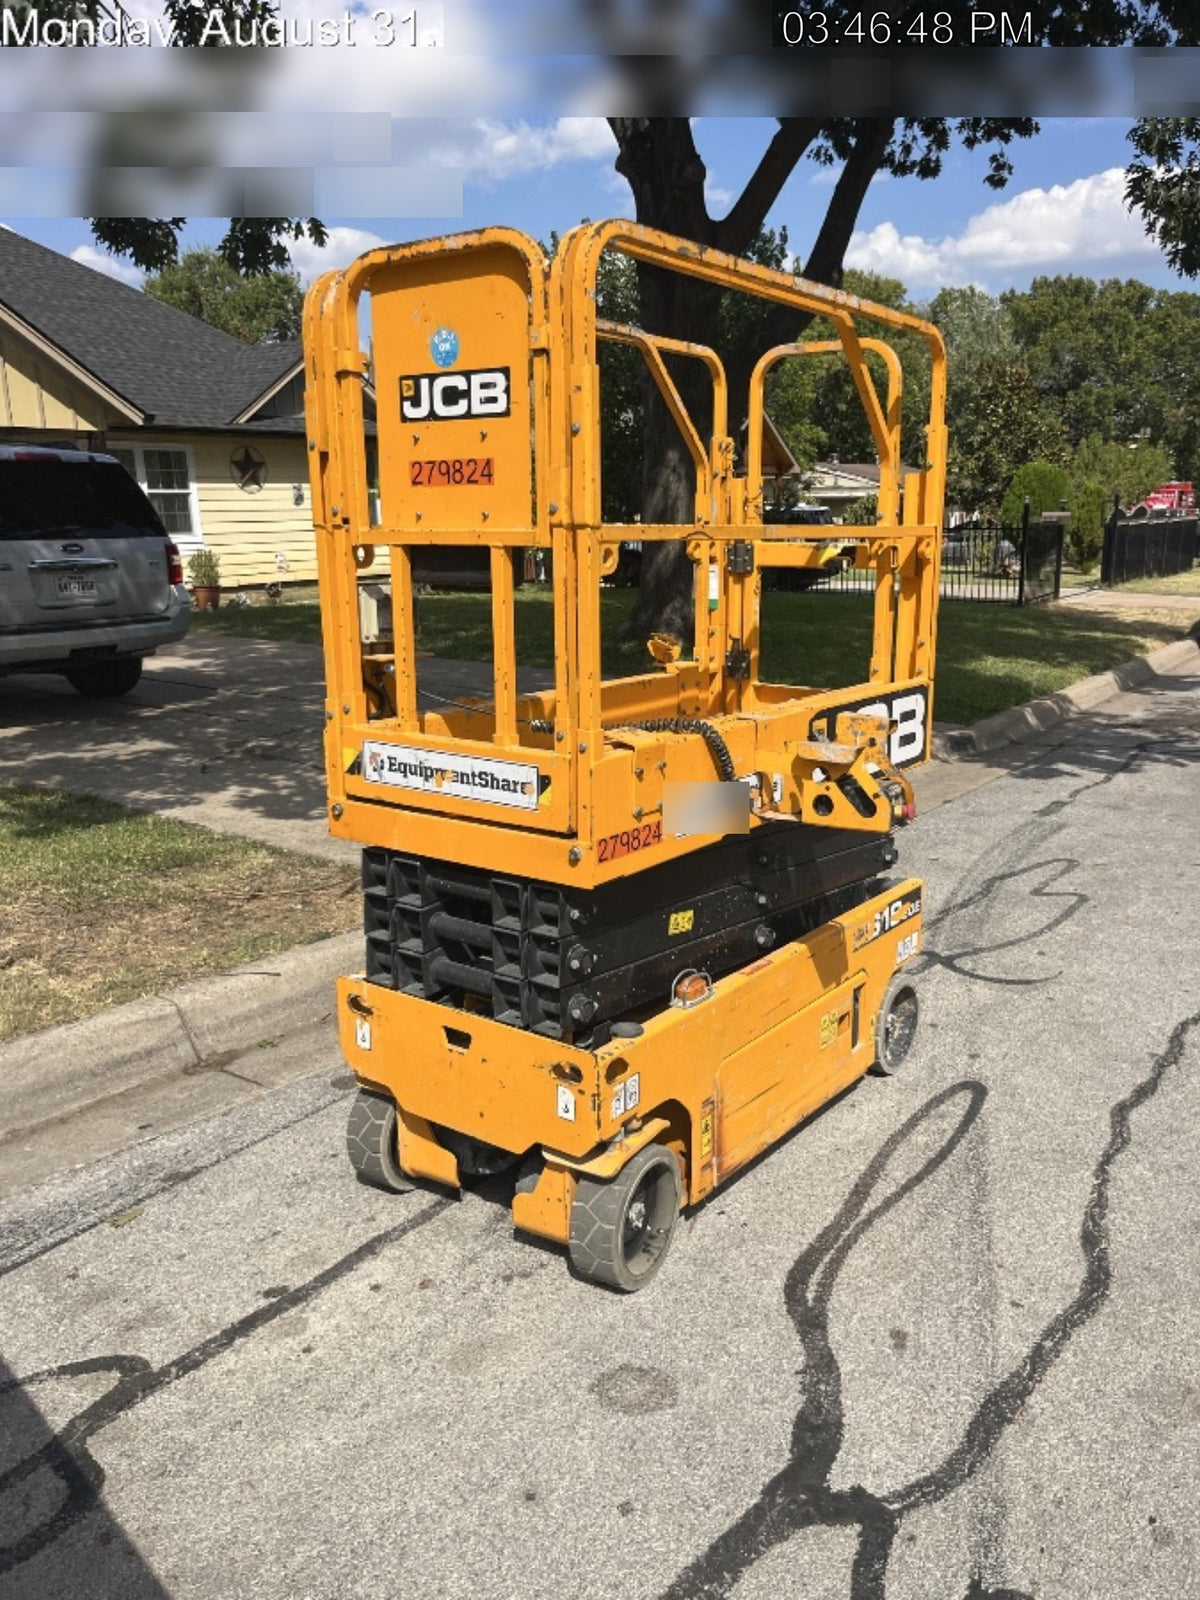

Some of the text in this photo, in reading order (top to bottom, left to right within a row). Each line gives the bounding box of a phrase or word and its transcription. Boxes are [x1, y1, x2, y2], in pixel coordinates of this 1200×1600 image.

[402, 372, 507, 419] JCB
[411, 459, 493, 486] 279824
[598, 821, 662, 863] 279824
